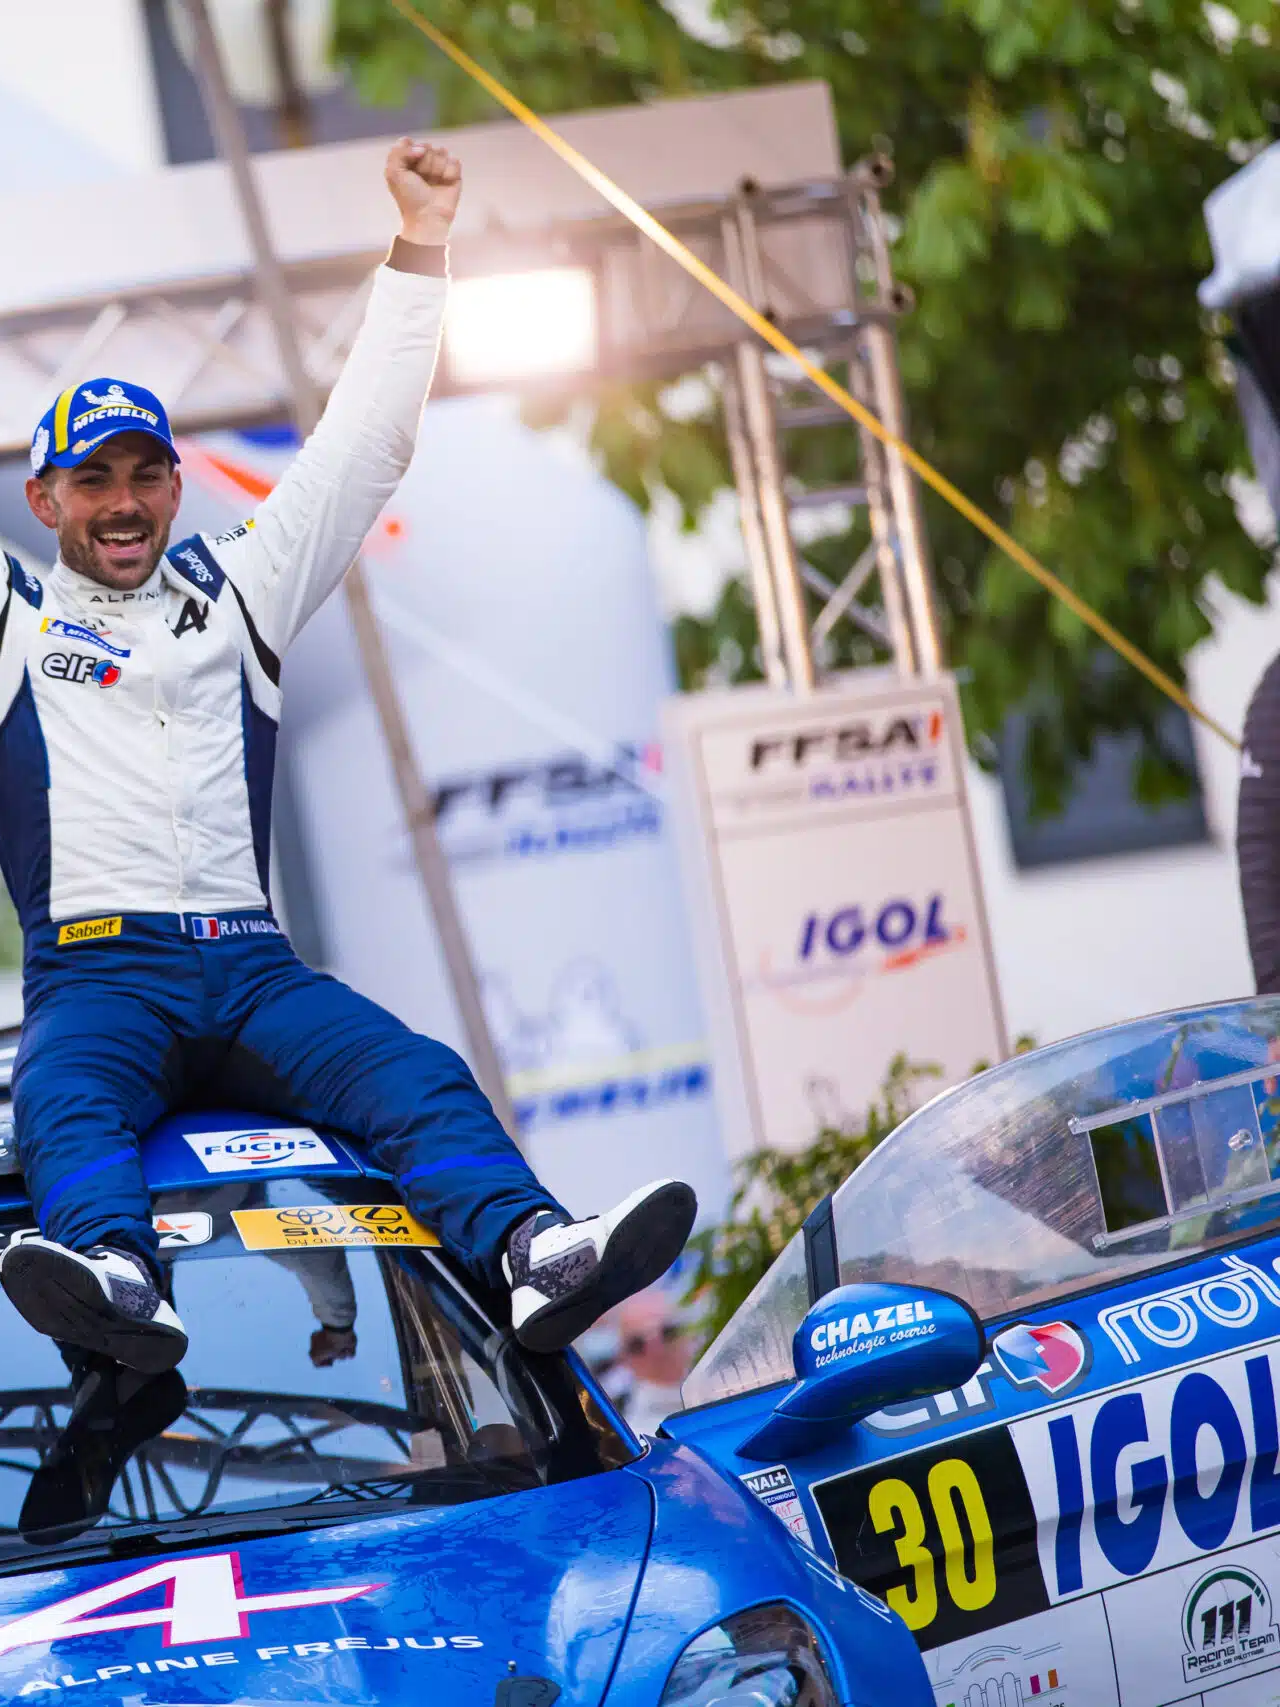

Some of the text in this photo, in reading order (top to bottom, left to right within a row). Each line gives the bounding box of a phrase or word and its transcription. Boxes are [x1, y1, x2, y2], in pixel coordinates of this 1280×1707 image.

[72, 406, 158, 432] MICHELIN
[42, 652, 98, 684] elf
[65, 918, 118, 941] Sabelt
[797, 893, 952, 962] IGOL
[204, 1139, 317, 1156] FUCHS
[282, 1225, 410, 1237] SIVAM
[287, 1234, 415, 1246] by autosphere
[810, 1300, 933, 1352] CHAZEL
[815, 1323, 937, 1368] technologie course
[746, 1471, 787, 1492] NAL+
[1047, 1355, 1280, 1597] IGOL
[868, 1458, 998, 1631] 30
[1201, 1593, 1253, 1651] 111
[20, 1651, 238, 1696] ALPINE
[257, 1635, 485, 1661] FREJUS
[1187, 1632, 1275, 1670] RACING TEAM
